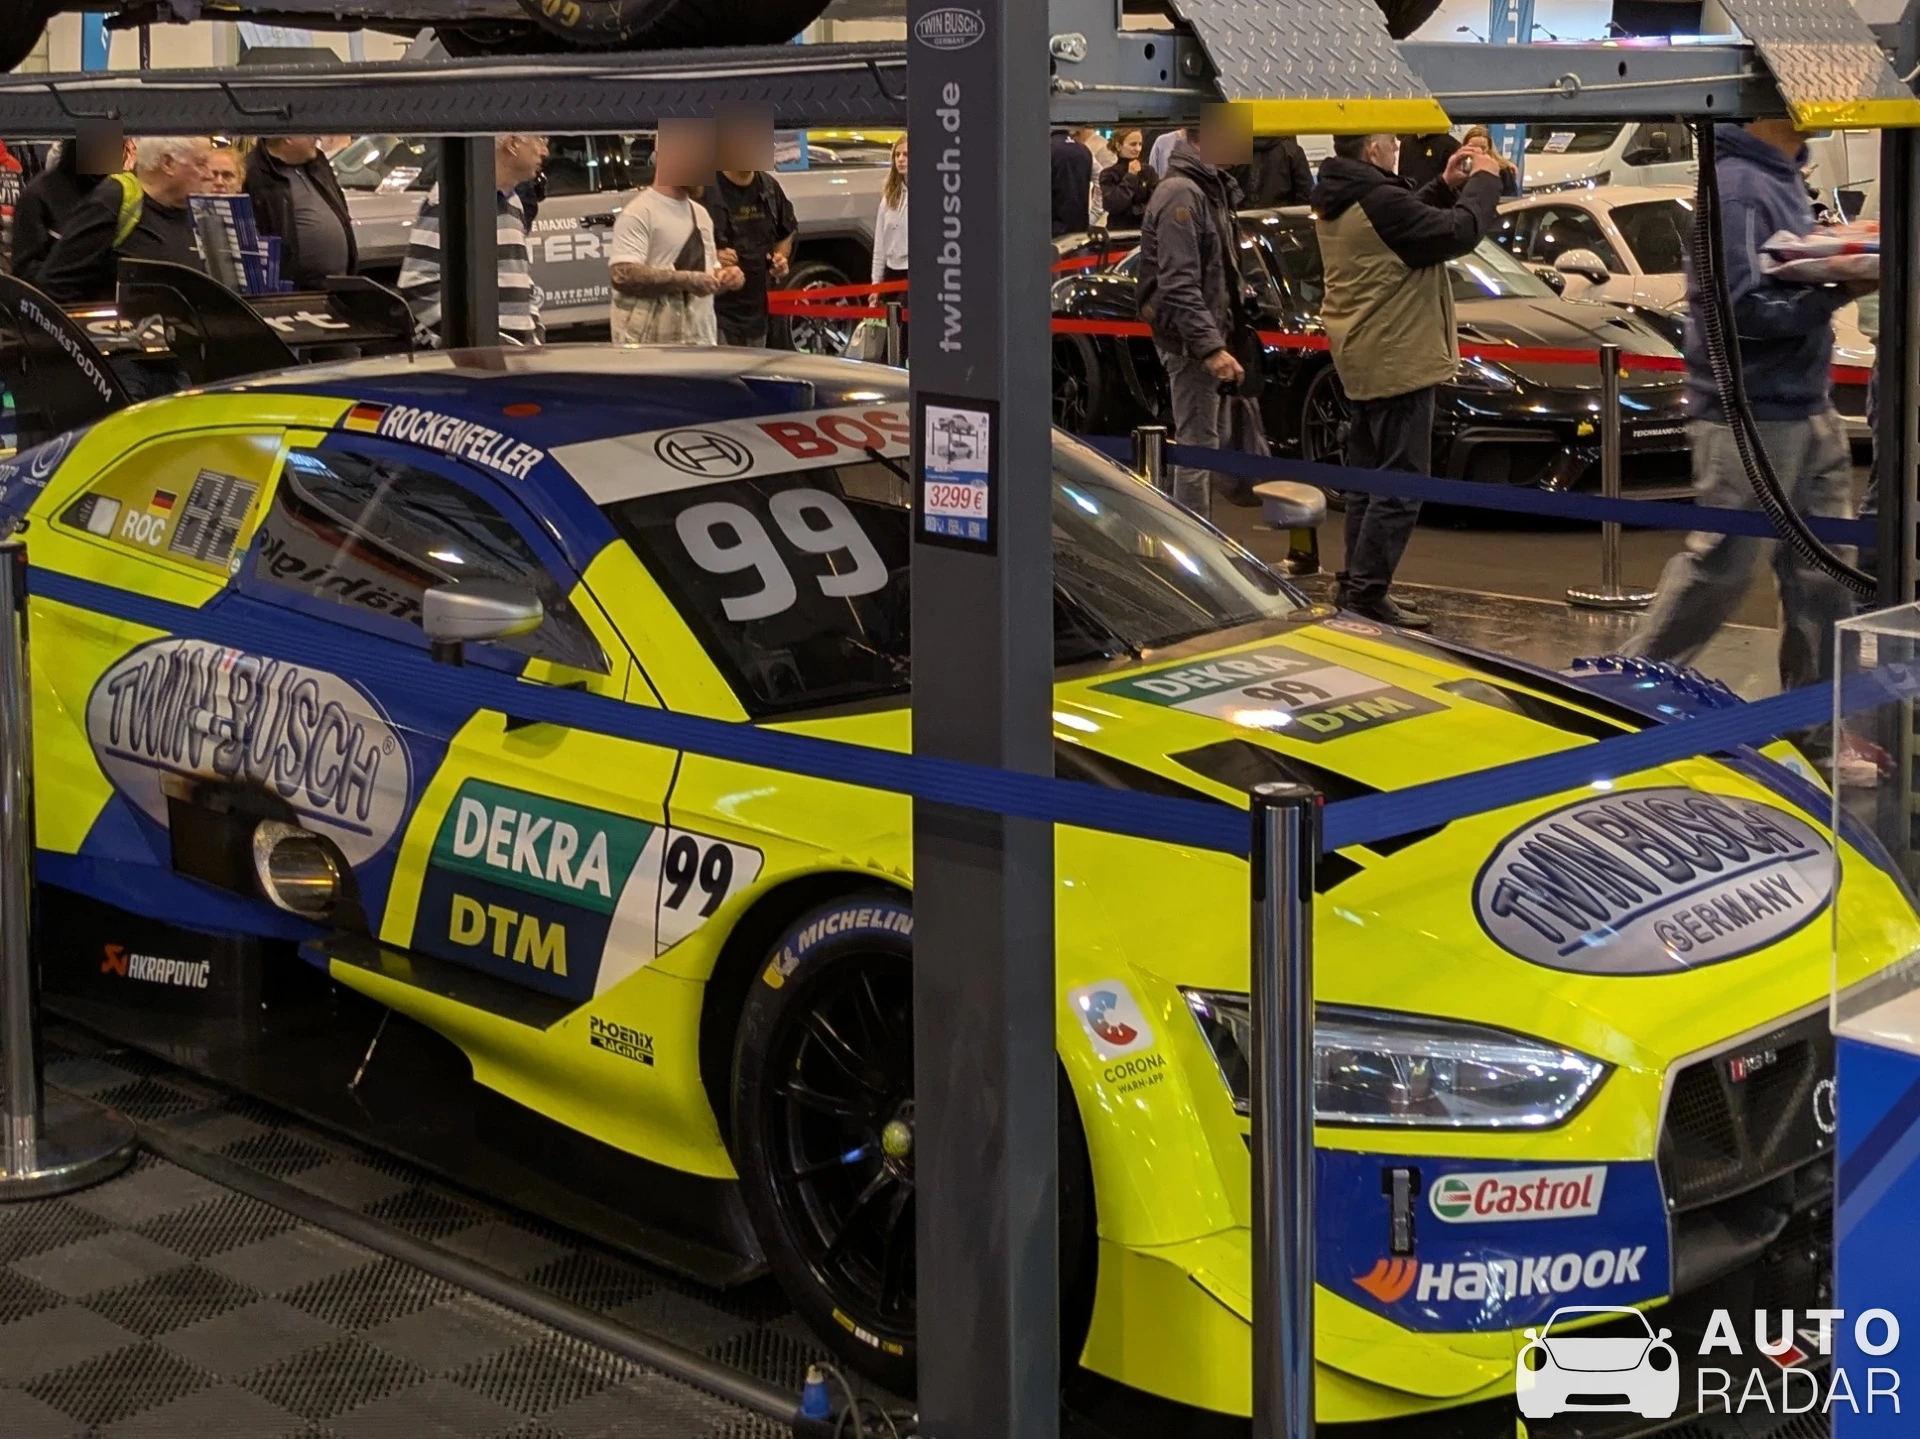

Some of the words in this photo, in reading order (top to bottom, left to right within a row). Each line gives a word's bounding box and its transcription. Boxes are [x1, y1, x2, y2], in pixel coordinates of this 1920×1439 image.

[920, 13, 942, 34] TWIN
[944, 12, 978, 33] BUSCH
[934, 37, 965, 45] GERMANY
[539, 217, 578, 231] MAXUS
[936, 82, 962, 352] twinbusch.de
[20, 299, 112, 403] #ThanksToDTM
[380, 405, 545, 481] ROCKENFELLER
[756, 410, 910, 460] BOS
[930, 485, 971, 509] 3299
[121, 509, 165, 547] ROC
[675, 488, 889, 622] 99
[1132, 655, 1309, 698] DEKRA
[1242, 680, 1332, 708] 99
[108, 648, 225, 769] TWIN
[1296, 696, 1416, 733] DTM
[453, 796, 612, 898] DEKRA
[1572, 798, 1805, 884] BUSCH
[664, 835, 734, 918] 99
[1491, 823, 1662, 943] TWIN
[449, 893, 568, 977] DTM
[798, 908, 914, 953] MICHELIN
[1654, 873, 1804, 952] GERMANY
[128, 953, 210, 989] AKRAPOVIČ
[1103, 1053, 1167, 1084] CORONA
[1474, 1173, 1593, 1216] Castrol
